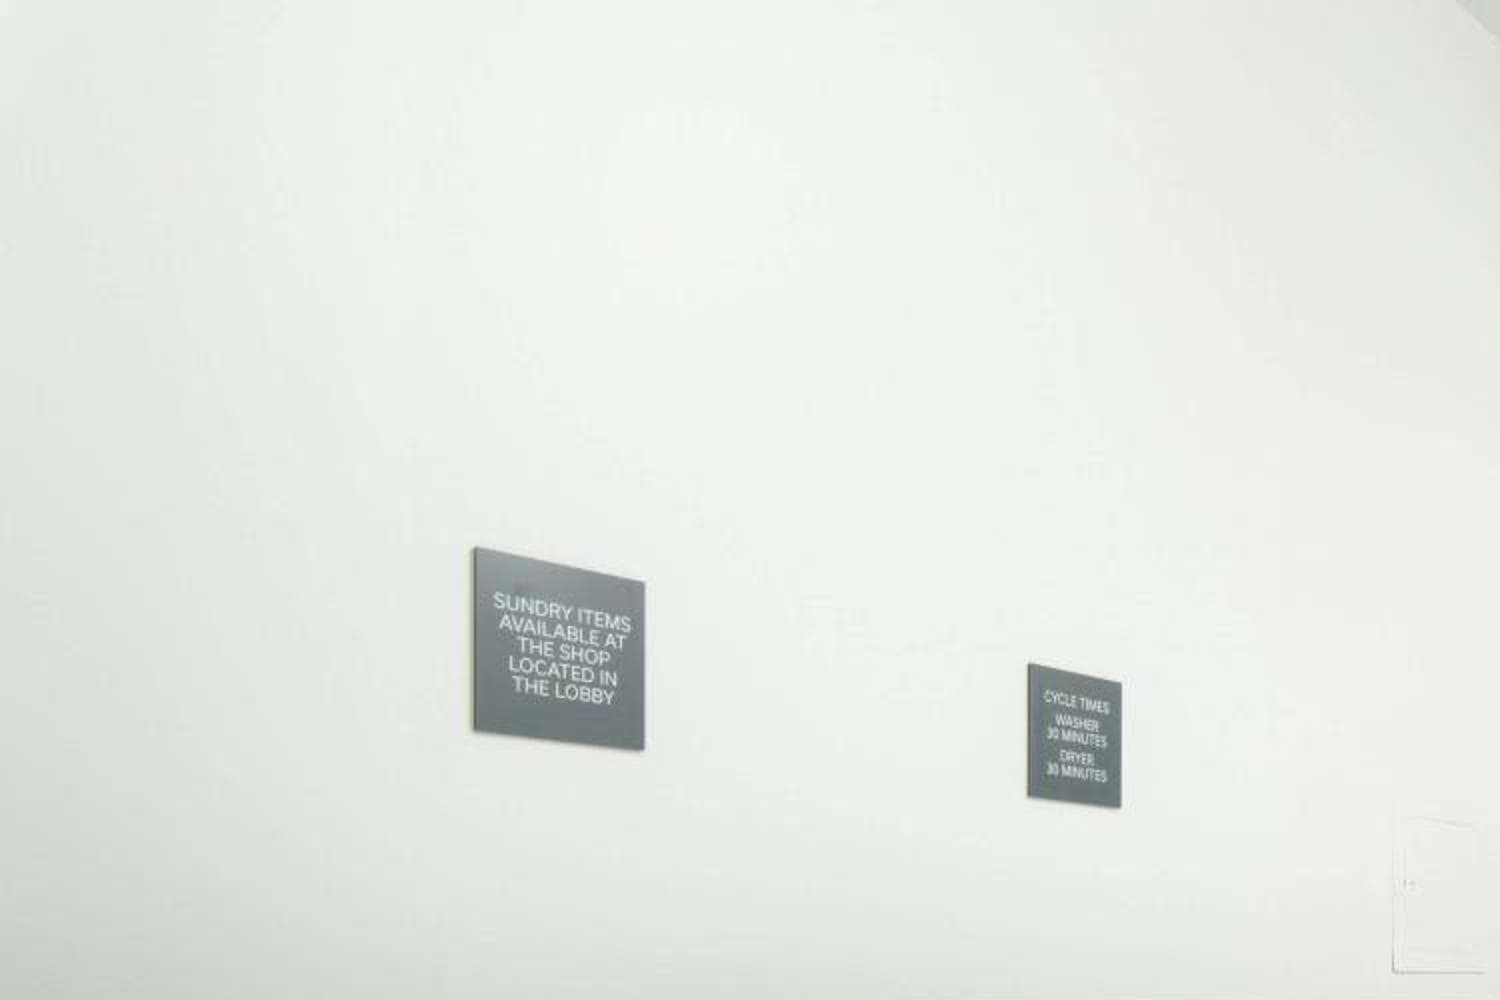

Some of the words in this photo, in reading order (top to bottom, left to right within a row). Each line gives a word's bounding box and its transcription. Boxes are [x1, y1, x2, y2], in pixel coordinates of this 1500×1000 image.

[493, 591, 573, 621] SUNDRY
[577, 607, 632, 633] ITEMS
[499, 614, 600, 646] AVAILABLE
[604, 633, 627, 650] AT
[517, 635, 554, 657] THE
[559, 643, 611, 667] SHOP
[508, 655, 595, 683] LOCATED
[599, 670, 617, 687] IN
[512, 675, 549, 697] THE
[555, 682, 615, 705] LOBBY
[1043, 689, 1077, 709] CYCLE
[1080, 697, 1110, 715] TIMES
[1055, 713, 1099, 732] WASHER
[1061, 728, 1108, 747] MINUTES
[1059, 749, 1095, 766] DRYER
[1061, 764, 1108, 783] MINUTES
